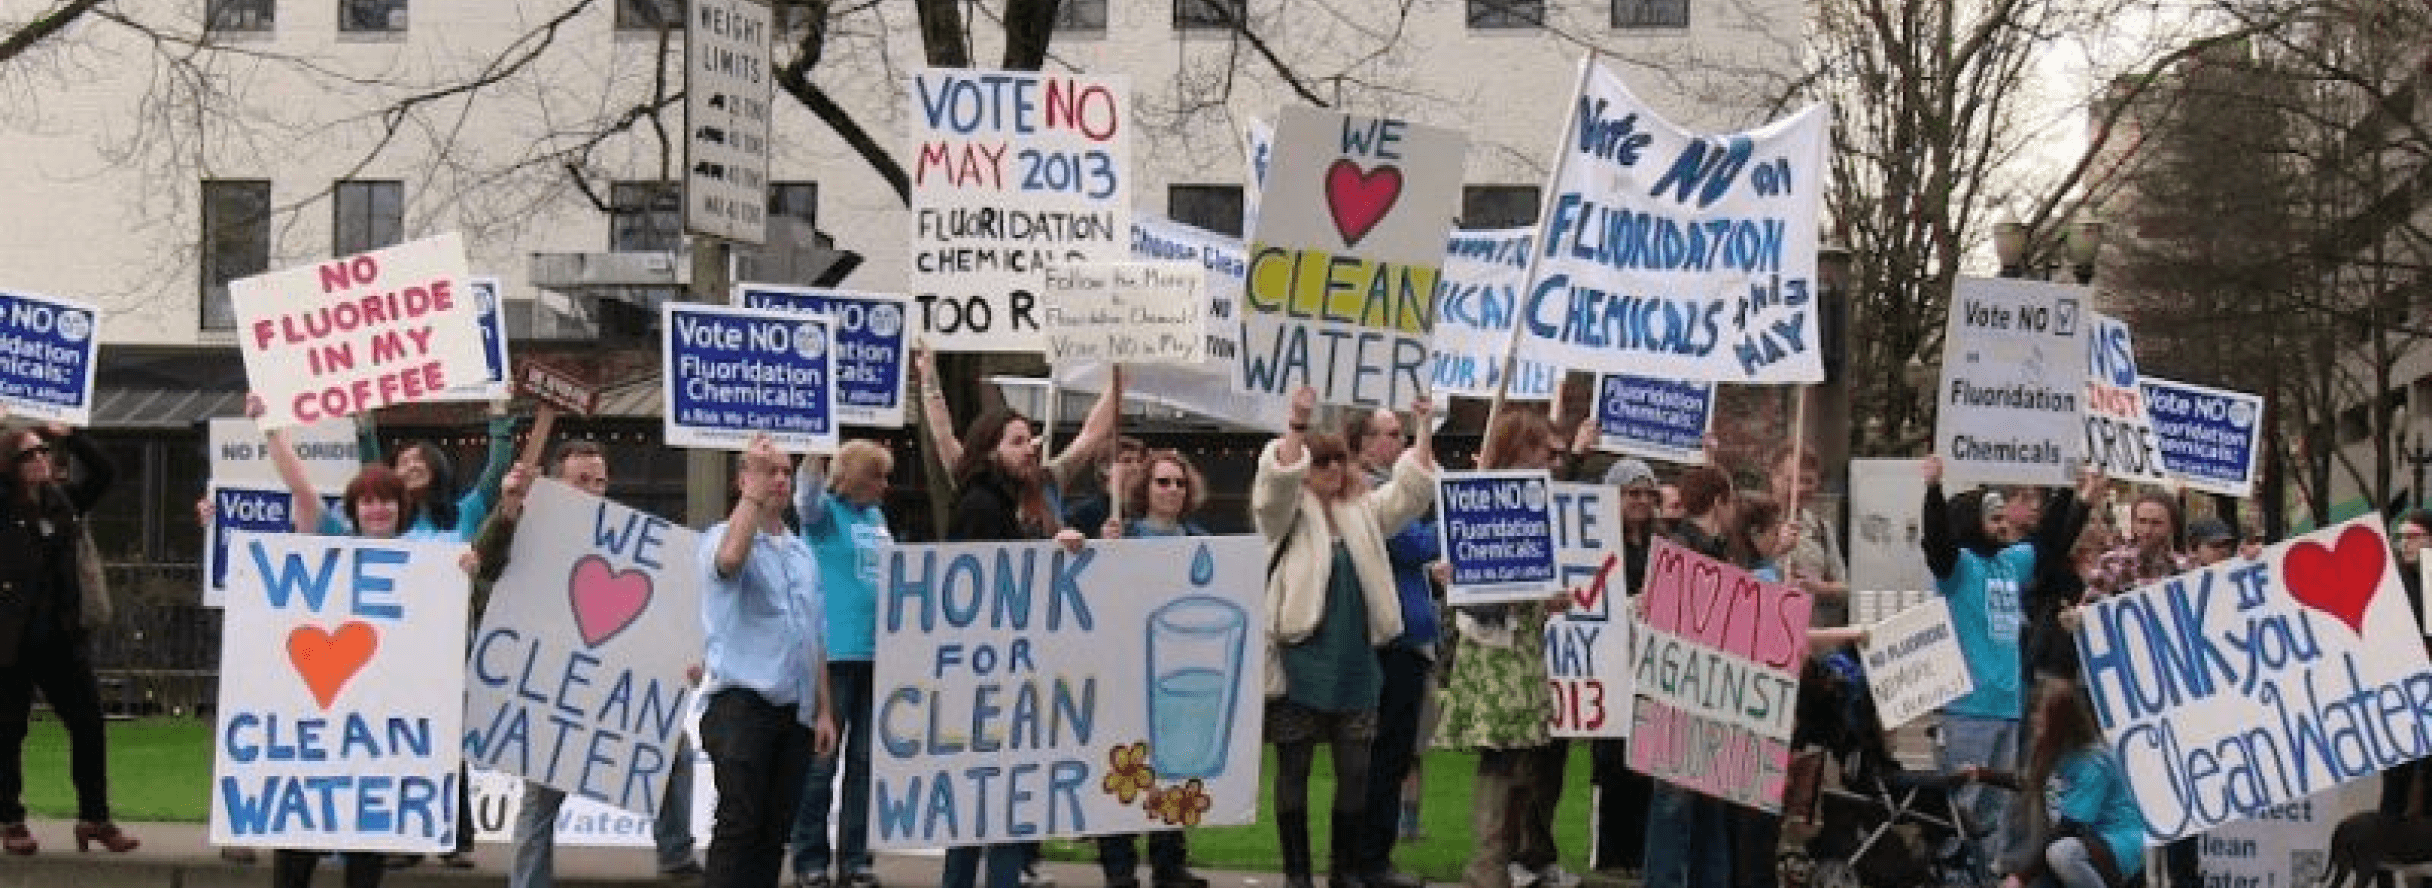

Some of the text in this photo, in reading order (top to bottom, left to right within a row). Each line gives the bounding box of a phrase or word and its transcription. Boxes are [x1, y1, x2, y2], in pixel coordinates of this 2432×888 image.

[704, 43, 761, 84] LIMITS
[914, 75, 1117, 142] VOTE NO
[1343, 115, 1404, 158] WE
[915, 141, 1116, 199] MAY 2013
[1581, 95, 1791, 208] Vote NO on
[917, 207, 1114, 241] FLUORIDATION
[1546, 191, 1785, 273] FLUORIDATION
[320, 255, 377, 293] NO
[1246, 247, 1441, 333] CLEAN
[11, 301, 53, 333] NO
[254, 281, 453, 350] FLUORIDE
[678, 314, 744, 350] Vote
[751, 323, 789, 354] NO
[914, 294, 992, 334] TOO
[1526, 274, 1724, 357] CHEMICALS
[1963, 301, 2048, 332] Vote NO
[308, 341, 355, 375] IN
[372, 325, 432, 366] MY
[681, 353, 822, 386] Fluoridation
[1241, 322, 1428, 406] WATER
[295, 362, 445, 421] COFFEE
[687, 378, 816, 409] Chemicals:
[1951, 378, 2075, 412] Fluoridation
[2195, 397, 2226, 421] NO
[222, 440, 252, 461] NO
[1953, 434, 2060, 465] Chemicals
[220, 492, 285, 522] Vote
[1445, 482, 1520, 512] Vote NO
[1553, 493, 1602, 548] TE
[594, 502, 670, 569] WE
[1450, 518, 1549, 540] Fluoridation
[249, 539, 411, 618] WE
[887, 547, 1096, 633] HONK
[1646, 547, 1801, 668] MOMS
[935, 638, 1035, 678] FOR
[2073, 570, 2238, 729] HONK
[2228, 562, 2268, 611] IF
[2224, 611, 2322, 696] you
[473, 627, 686, 743] CLEAN
[1635, 628, 1796, 727] AGAINST
[224, 710, 432, 764] CLEAN
[879, 677, 1096, 759] CLEAN
[462, 699, 664, 815] WATER
[2118, 718, 2293, 840] Clean
[220, 771, 456, 847] WATER!
[876, 759, 1089, 841] WATER
